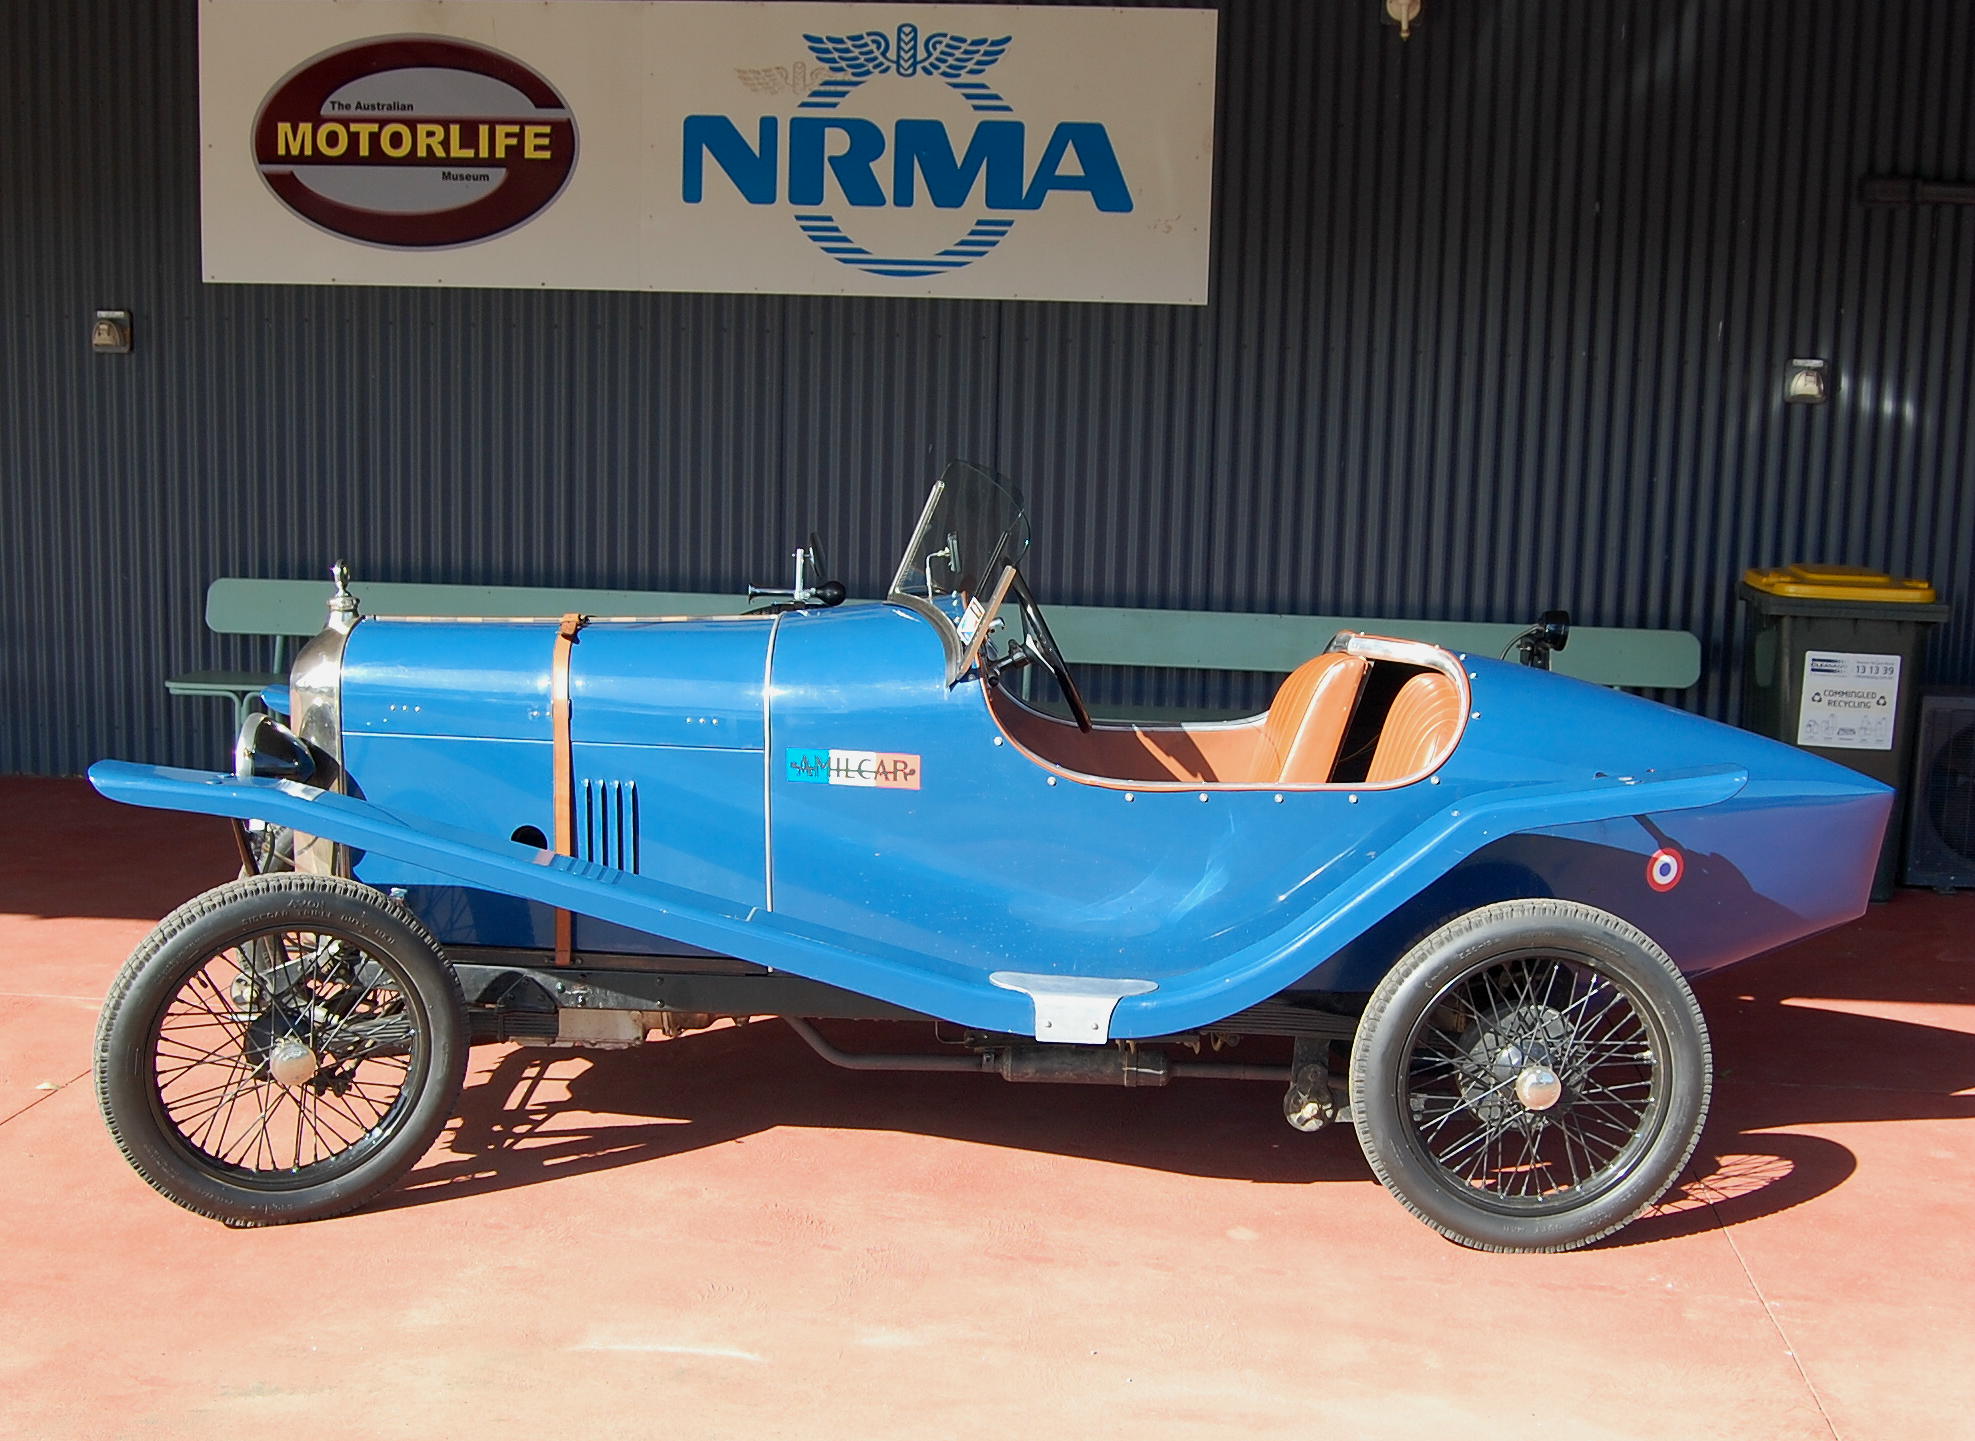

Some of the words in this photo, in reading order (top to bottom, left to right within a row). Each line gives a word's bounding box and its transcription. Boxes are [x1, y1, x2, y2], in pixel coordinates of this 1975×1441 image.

[330, 101, 351, 112] The
[355, 101, 414, 113] Australian
[277, 122, 551, 160] MOTORLIFE
[682, 115, 1134, 213] NRMA
[442, 171, 490, 183] Museum
[1856, 665, 1867, 674] 13
[1870, 665, 1880, 675] 13
[1882, 666, 1895, 676] 39
[1823, 689, 1877, 699] COMMINGLED
[1827, 700, 1872, 709] RECYCLING
[790, 754, 916, 782] AMILCAR
